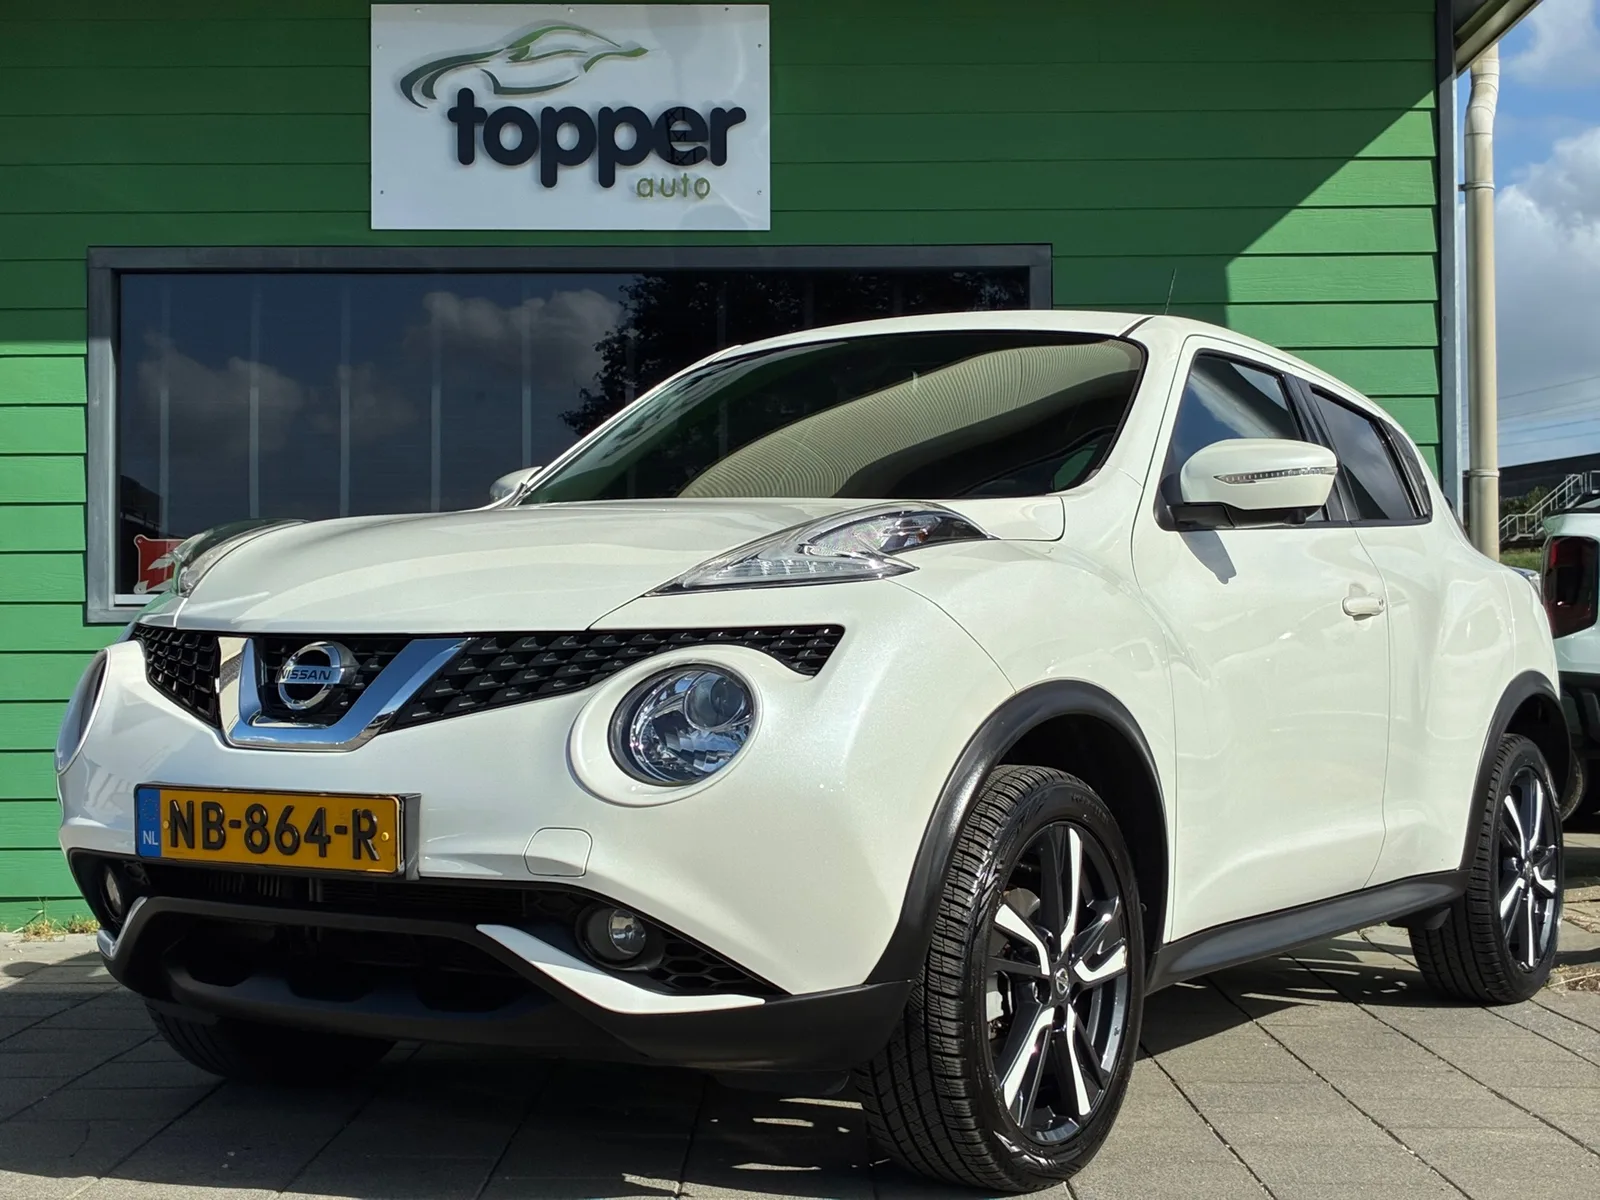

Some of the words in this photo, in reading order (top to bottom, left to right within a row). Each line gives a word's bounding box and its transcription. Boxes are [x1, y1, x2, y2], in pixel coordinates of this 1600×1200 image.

[447, 87, 747, 188] topper
[636, 173, 711, 198] auto
[281, 669, 332, 680] NISSAN
[142, 830, 159, 846] NL
[169, 799, 380, 861] NB-864-R
